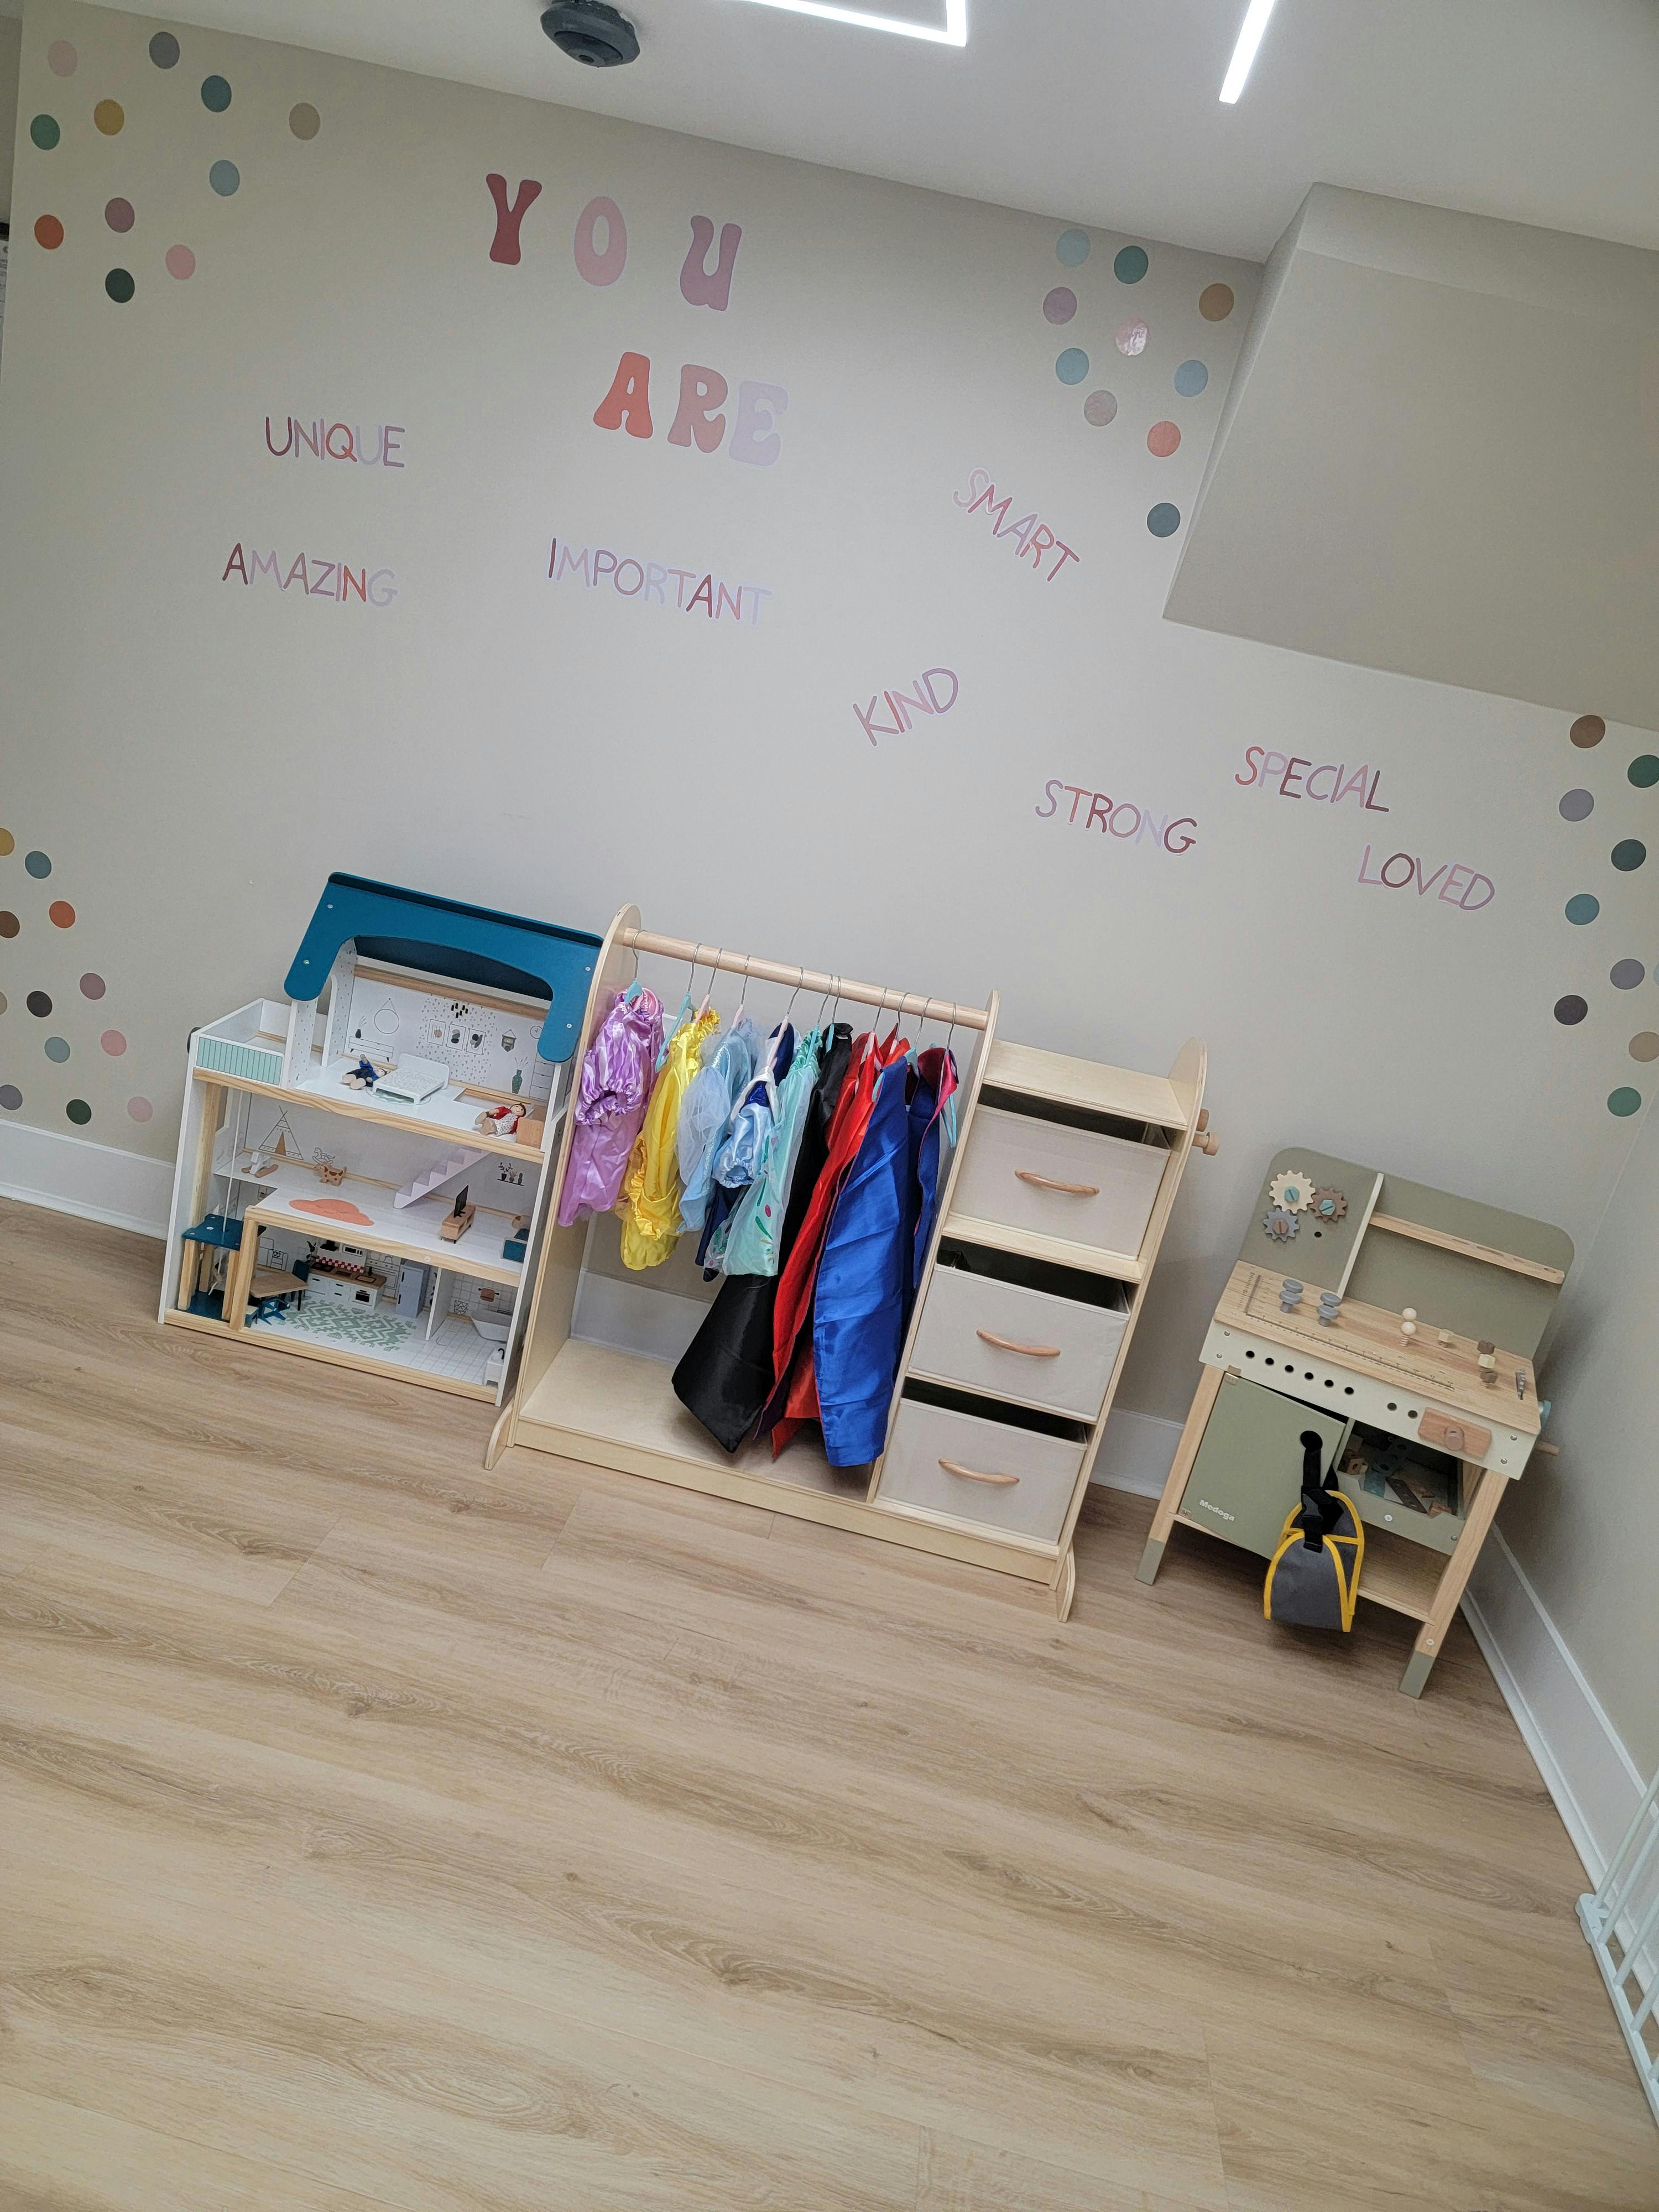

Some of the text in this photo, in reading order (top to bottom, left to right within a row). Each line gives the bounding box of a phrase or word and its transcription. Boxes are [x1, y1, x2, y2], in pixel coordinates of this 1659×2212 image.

[486, 172, 743, 312] YOU
[264, 416, 405, 469] UNIQUE
[593, 351, 789, 467] ARE
[953, 468, 1081, 583] SMART
[222, 542, 399, 607] AMAZING
[548, 537, 773, 626] IMPORTANT
[853, 667, 960, 747] KIND
[1234, 745, 1390, 812] SPECIAL
[1035, 779, 1198, 854] STRONG
[1357, 844, 1495, 911] LOVED
[1199, 1499, 1235, 1521] Medoga
